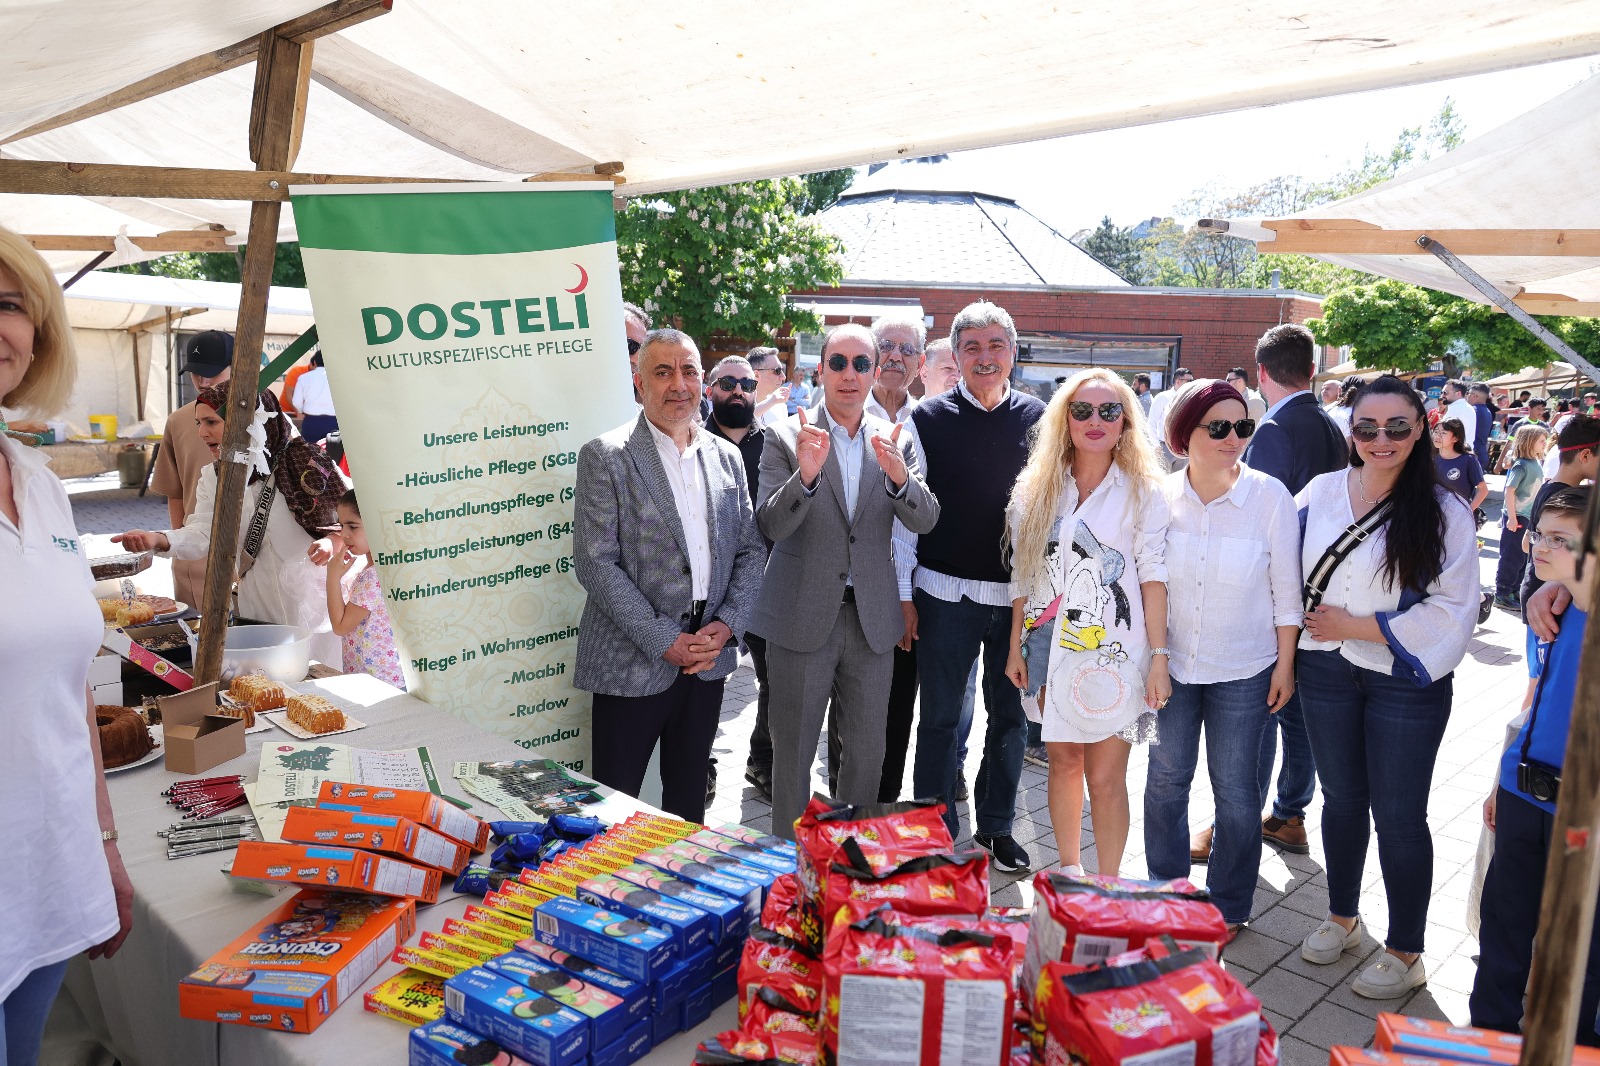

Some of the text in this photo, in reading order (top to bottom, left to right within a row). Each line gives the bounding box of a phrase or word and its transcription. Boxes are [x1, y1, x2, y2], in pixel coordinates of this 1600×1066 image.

[361, 293, 590, 346] DOSTELI
[367, 338, 593, 371] KULTURSPEZIFISCHE PFLEGE
[423, 421, 569, 448] Unsere Leistungen:
[396, 451, 577, 488] -Häusliche Pflege (SGB
[394, 487, 576, 527] -Behandlungspflege (S
[375, 527, 543, 567] -Entlastungsleistungen
[387, 562, 551, 602] -Verhinderungspflege
[411, 655, 457, 673] Pflege
[462, 648, 476, 662] in
[503, 662, 566, 685] -Moabit
[509, 698, 569, 718] -Rudow
[240, 941, 342, 957] CRUNCH
[403, 990, 441, 1004] SOUR
